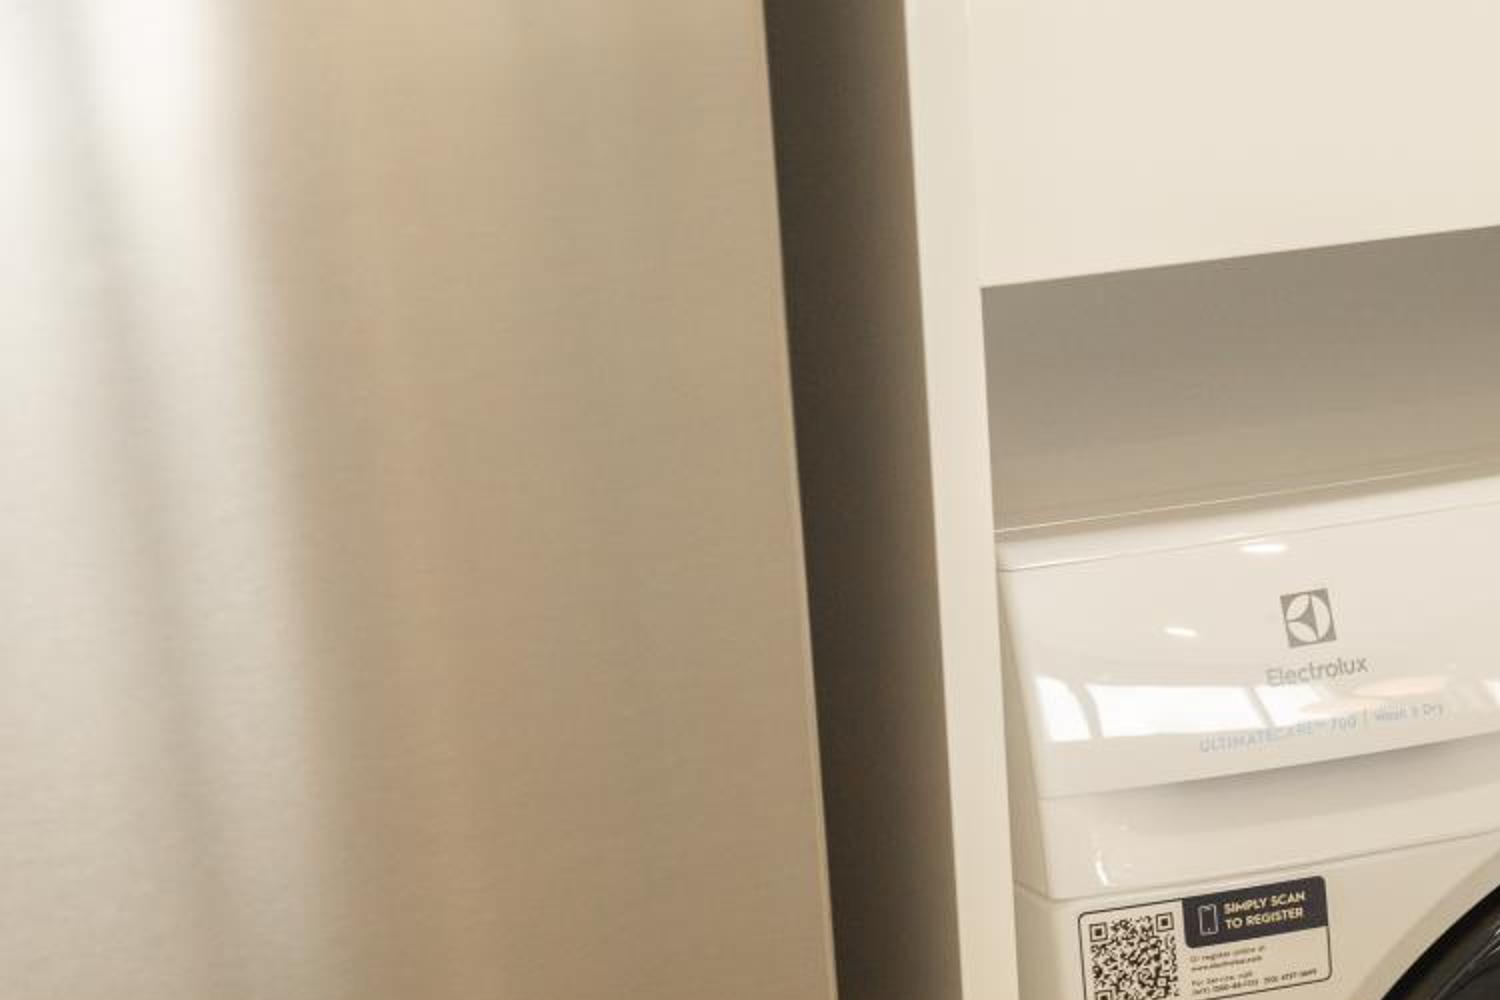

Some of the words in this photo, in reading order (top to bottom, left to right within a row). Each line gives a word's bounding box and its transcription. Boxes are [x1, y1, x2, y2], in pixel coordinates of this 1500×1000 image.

[1265, 656, 1368, 687] Electrolux
[1223, 897, 1269, 916] SIMPLY
[1271, 890, 1306, 907] SCAN
[1224, 916, 1243, 930] TO
[1246, 906, 1304, 928] REGISTER
